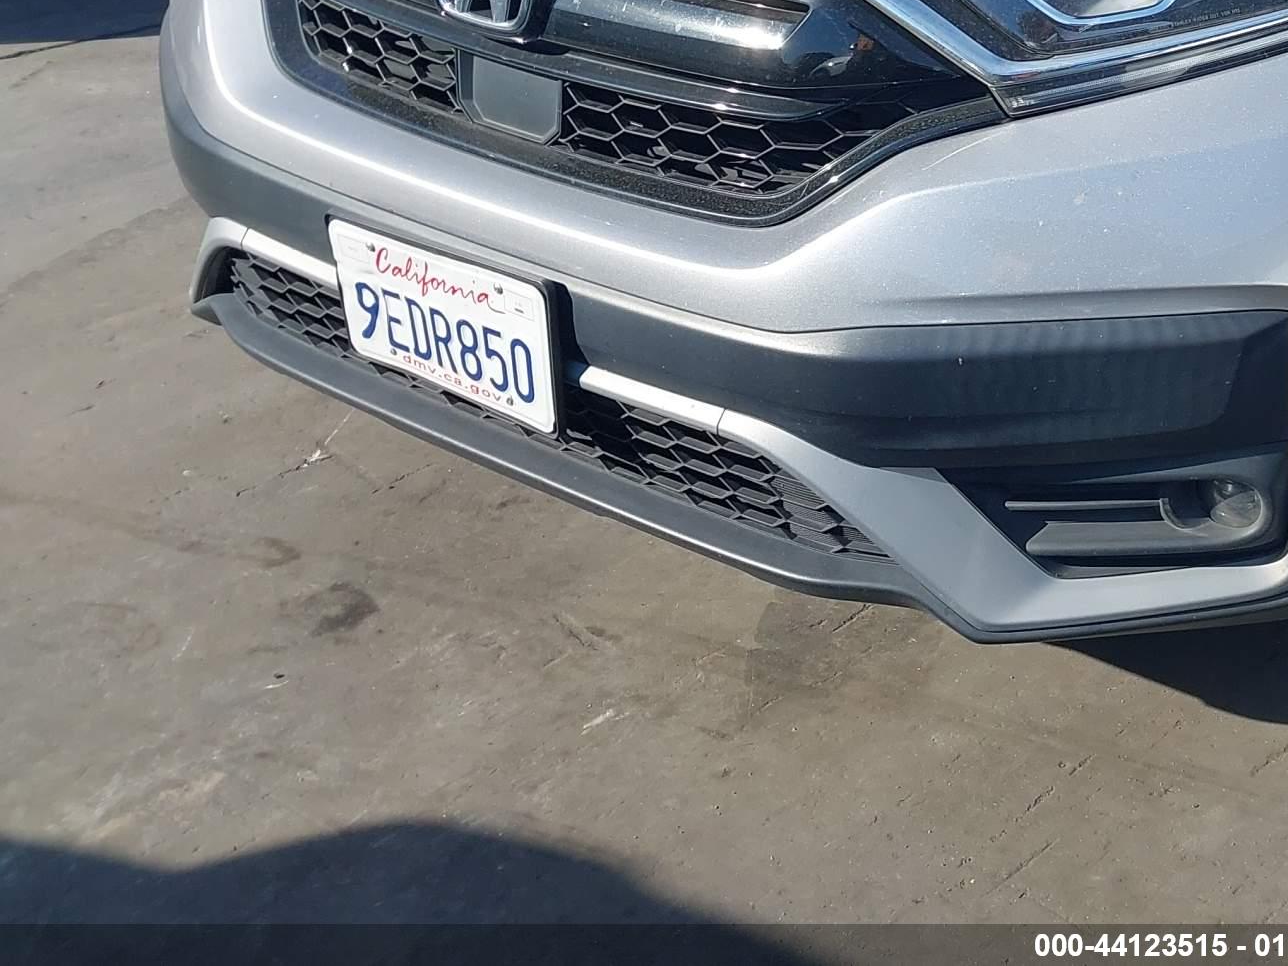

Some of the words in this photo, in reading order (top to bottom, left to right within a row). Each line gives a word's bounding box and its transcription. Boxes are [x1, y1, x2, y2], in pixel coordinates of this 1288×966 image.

[375, 247, 506, 315] California
[355, 281, 535, 404] 9EDR850
[403, 355, 503, 404] dmv.ca.gov
